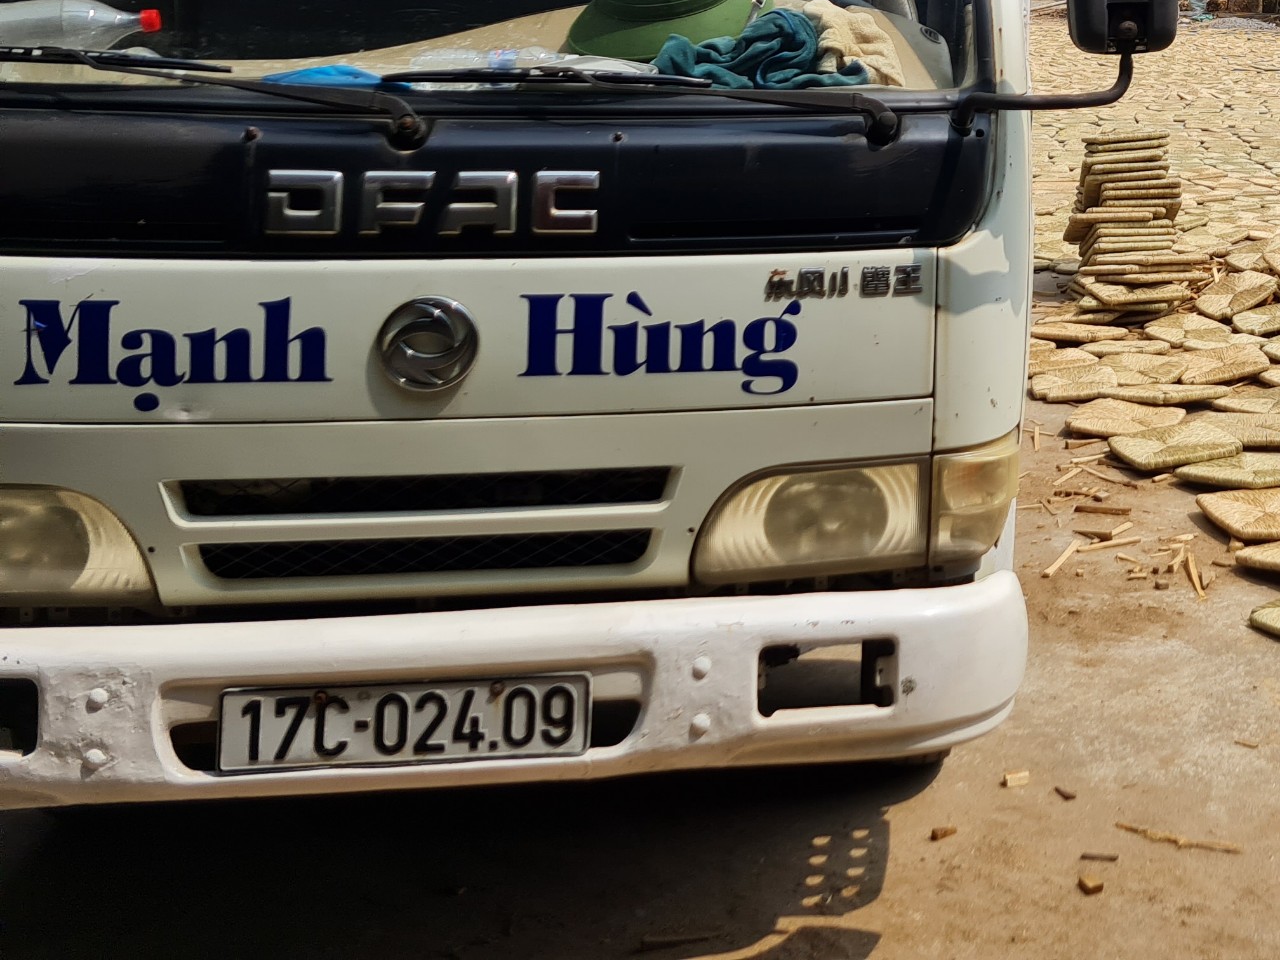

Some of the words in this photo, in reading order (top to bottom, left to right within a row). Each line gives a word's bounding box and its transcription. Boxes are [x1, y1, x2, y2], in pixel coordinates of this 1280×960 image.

[265, 169, 600, 235] DFAC
[14, 296, 334, 412] Mạnh
[517, 291, 802, 395] Hùng
[240, 683, 576, 766] 17C-024.09
